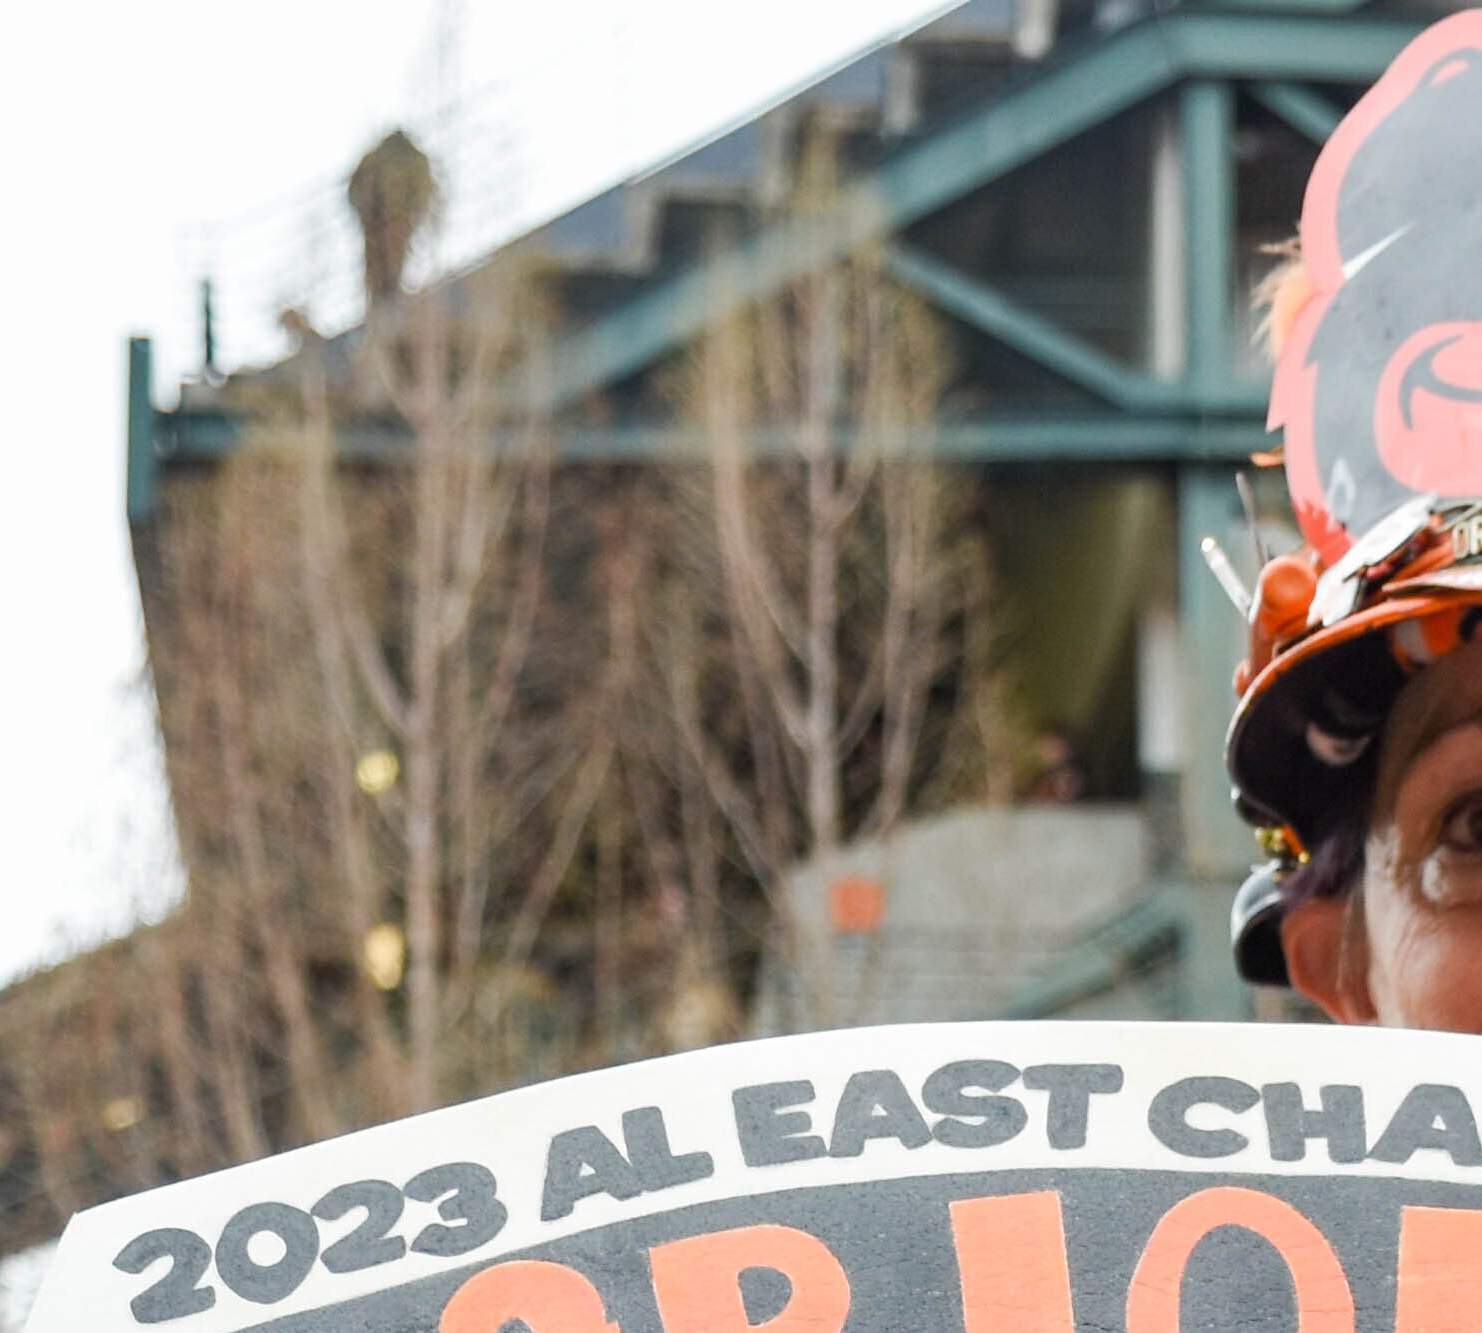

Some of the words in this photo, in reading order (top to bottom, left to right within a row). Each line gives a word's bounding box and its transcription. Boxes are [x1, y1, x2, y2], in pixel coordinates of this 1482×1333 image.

[112, 1162, 508, 1324] 2023
[540, 1106, 714, 1222] AL
[732, 1059, 1124, 1168] EAST
